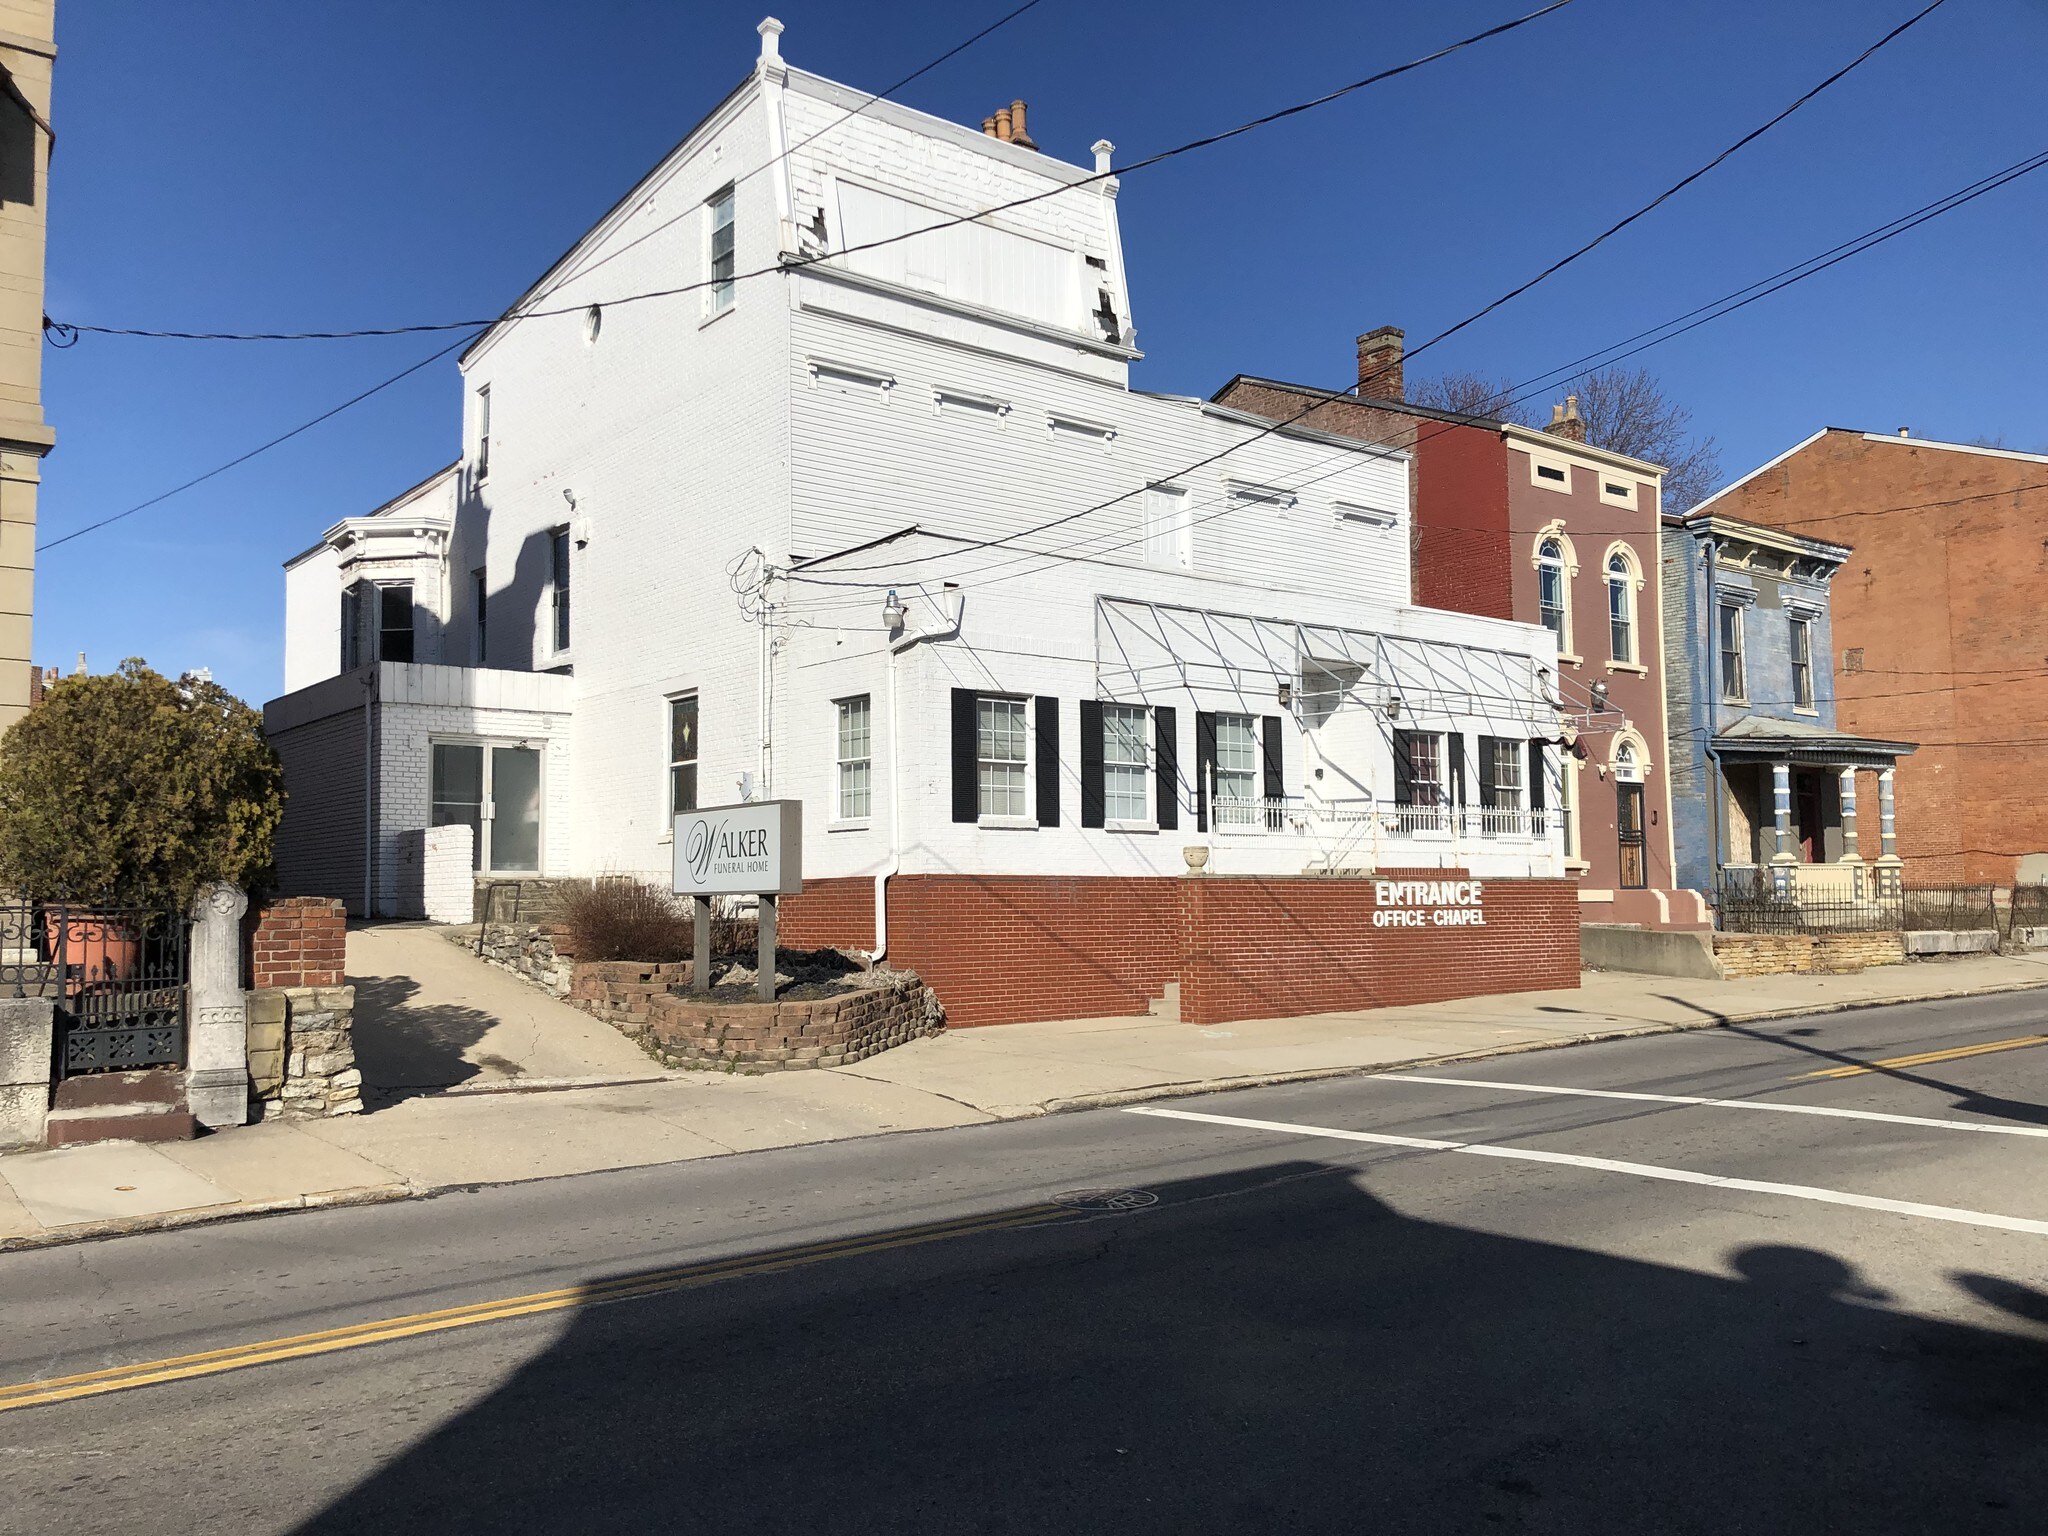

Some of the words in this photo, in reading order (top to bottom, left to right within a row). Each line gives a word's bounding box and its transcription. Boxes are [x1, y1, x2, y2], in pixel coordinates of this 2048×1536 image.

[686, 819, 768, 884] WALKER
[714, 863, 744, 874] FUNERAL
[747, 861, 768, 872] HOME
[1375, 881, 1483, 906] ENTRANCE
